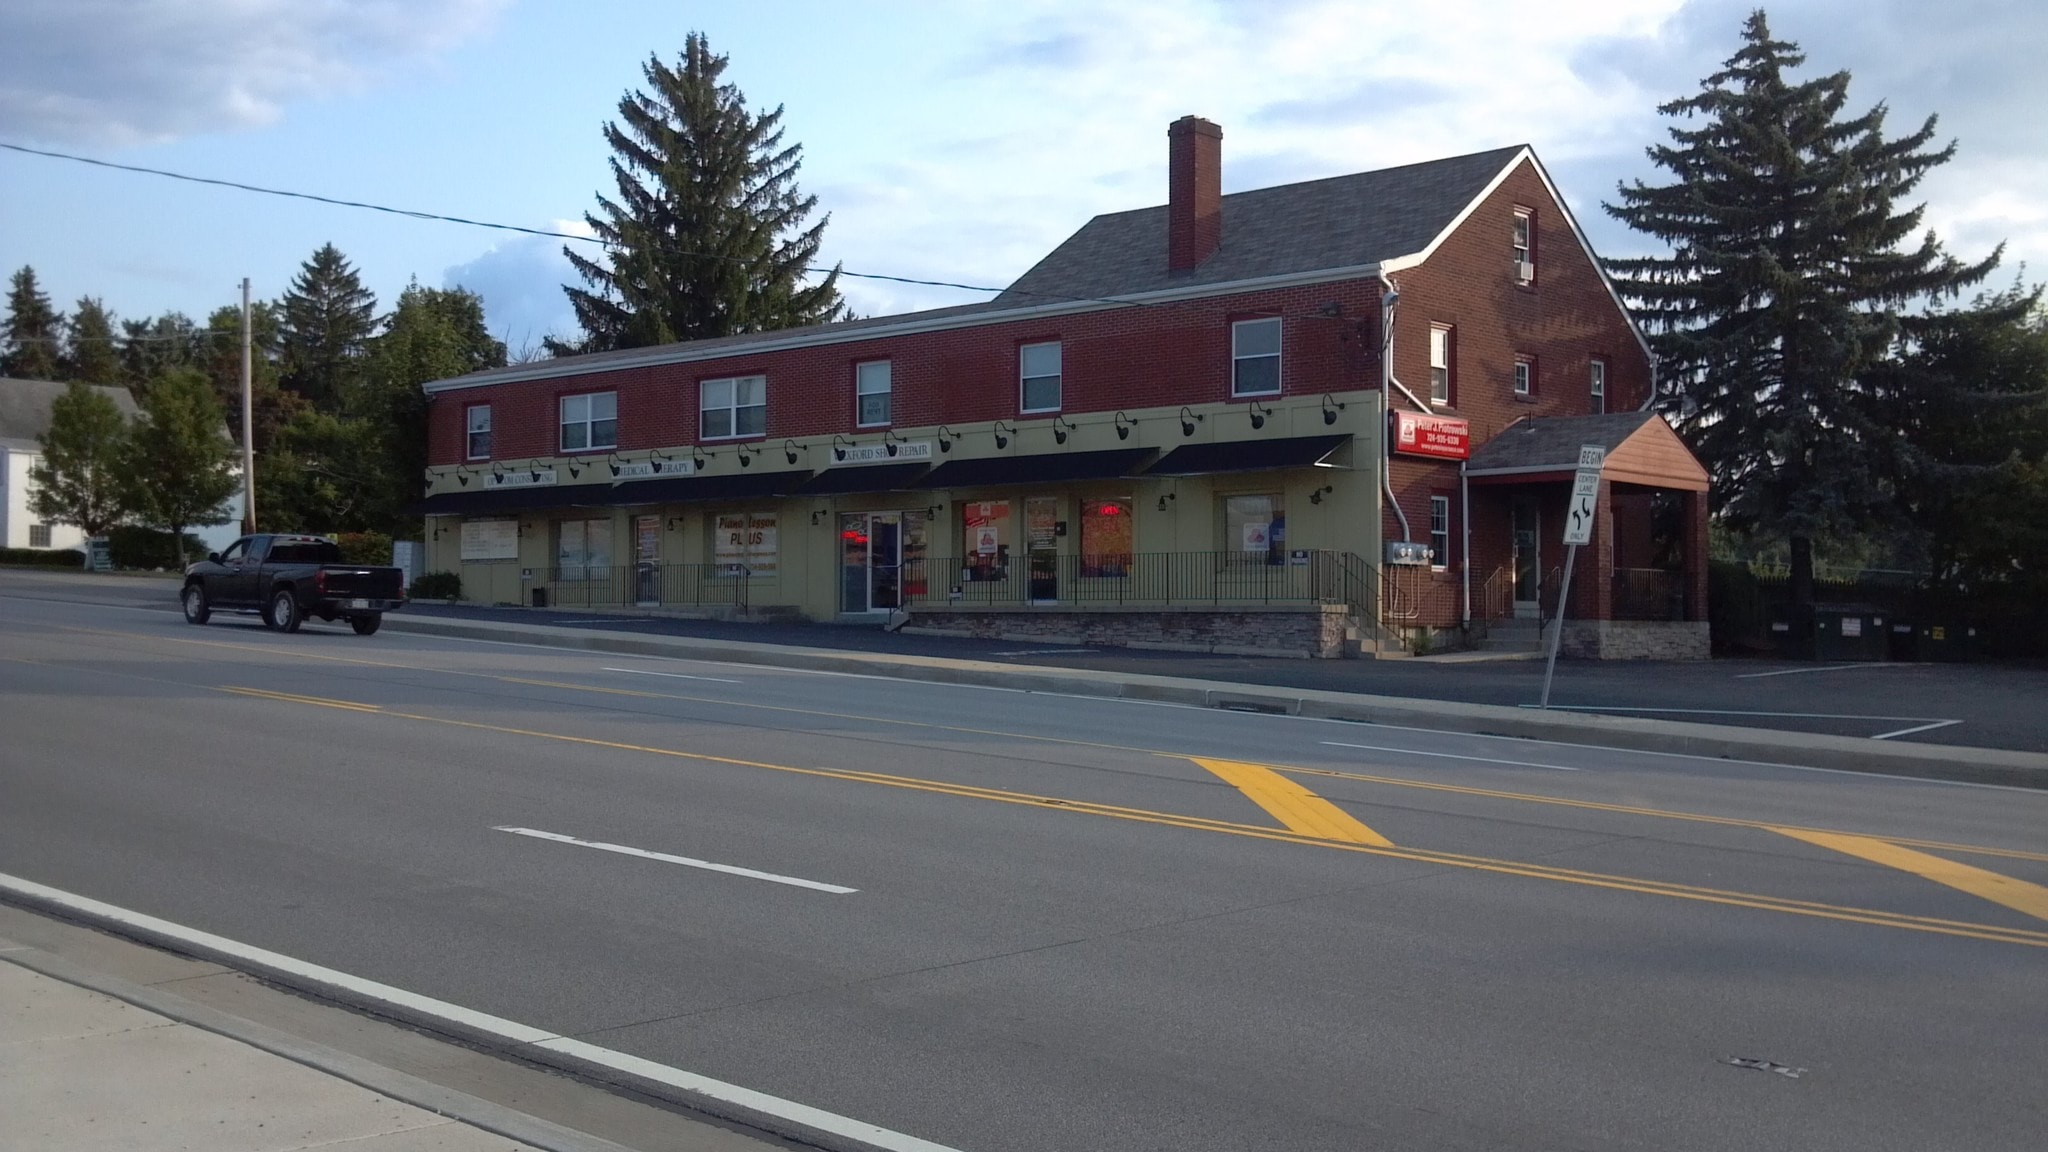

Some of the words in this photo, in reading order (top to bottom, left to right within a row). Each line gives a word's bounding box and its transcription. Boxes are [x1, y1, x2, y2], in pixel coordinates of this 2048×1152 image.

[1417, 419, 1433, 431] Peter
[834, 449, 874, 460] XFORD
[899, 444, 928, 457] REPAIR
[1581, 450, 1603, 465] BEGIN
[653, 462, 689, 474] ERAPY
[1578, 475, 1598, 483] CENTER
[1579, 484, 1593, 493] LANE
[719, 517, 744, 529] Piano
[1570, 532, 1584, 540] ONLY
